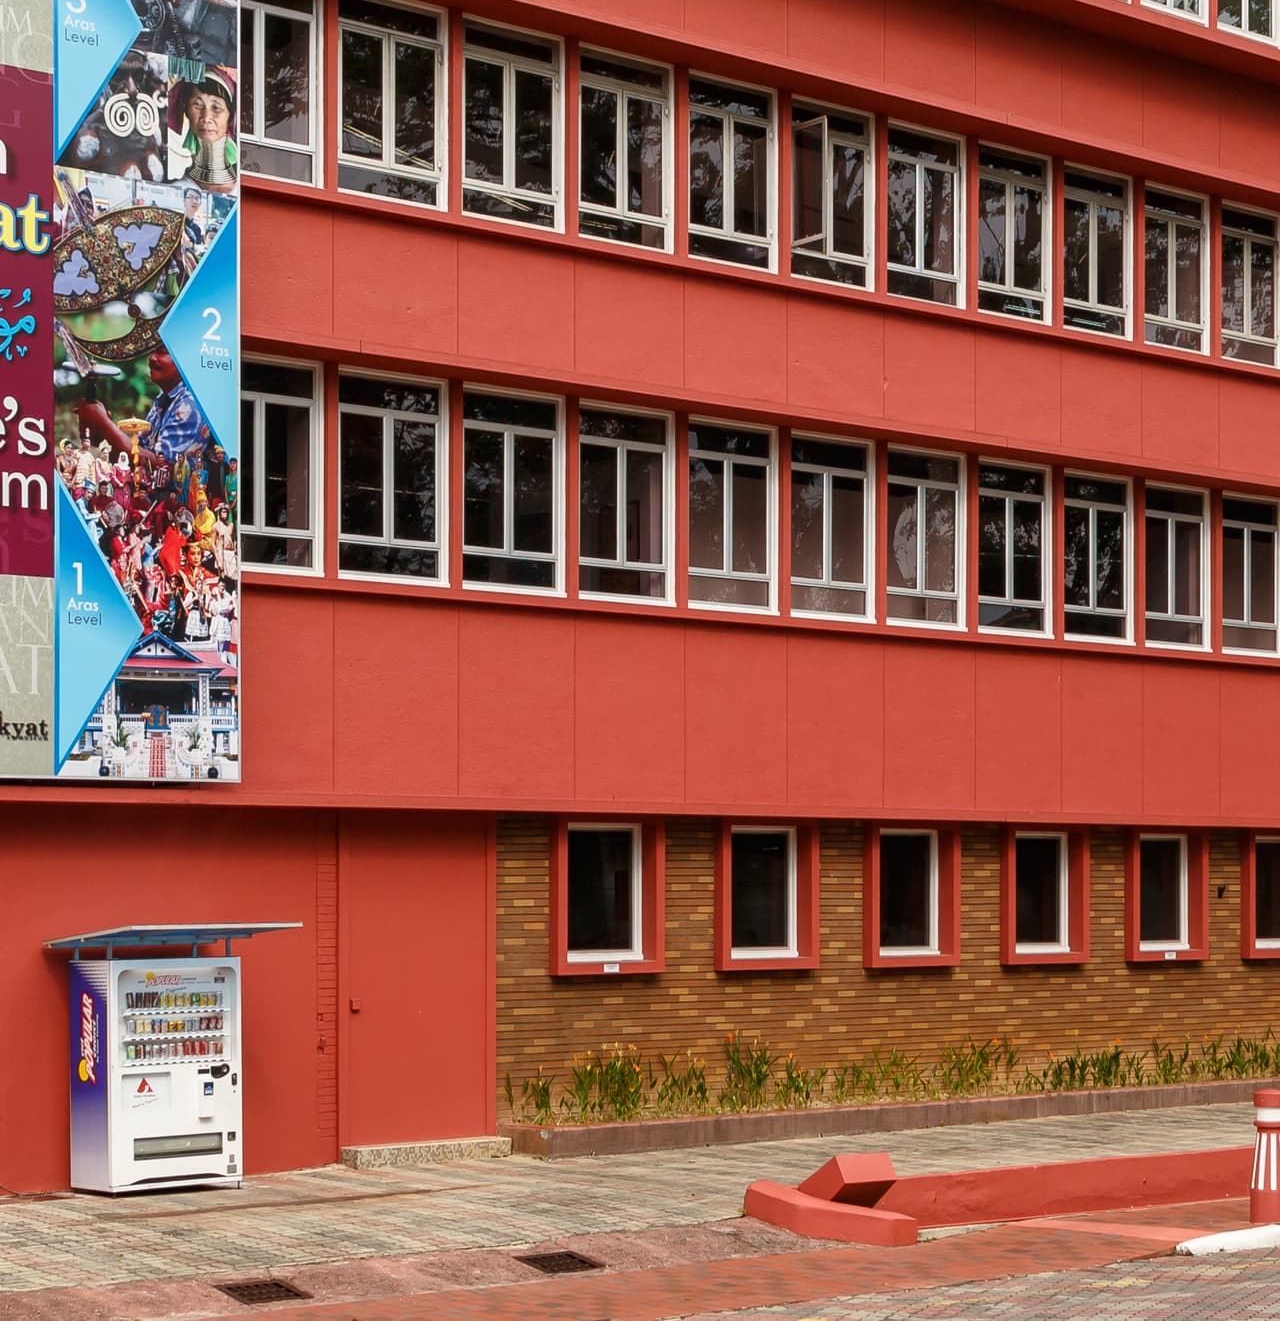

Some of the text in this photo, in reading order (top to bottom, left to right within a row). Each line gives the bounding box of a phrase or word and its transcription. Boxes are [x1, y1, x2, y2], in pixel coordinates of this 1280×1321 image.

[63, 13, 96, 32] Aras
[64, 28, 99, 47] Level
[201, 306, 222, 341] 2
[200, 341, 230, 358] Aras
[200, 355, 233, 372] Level
[71, 561, 83, 596] 1
[67, 597, 99, 612] Aras
[67, 611, 102, 627] Level
[80, 991, 97, 1086] POPULAR
